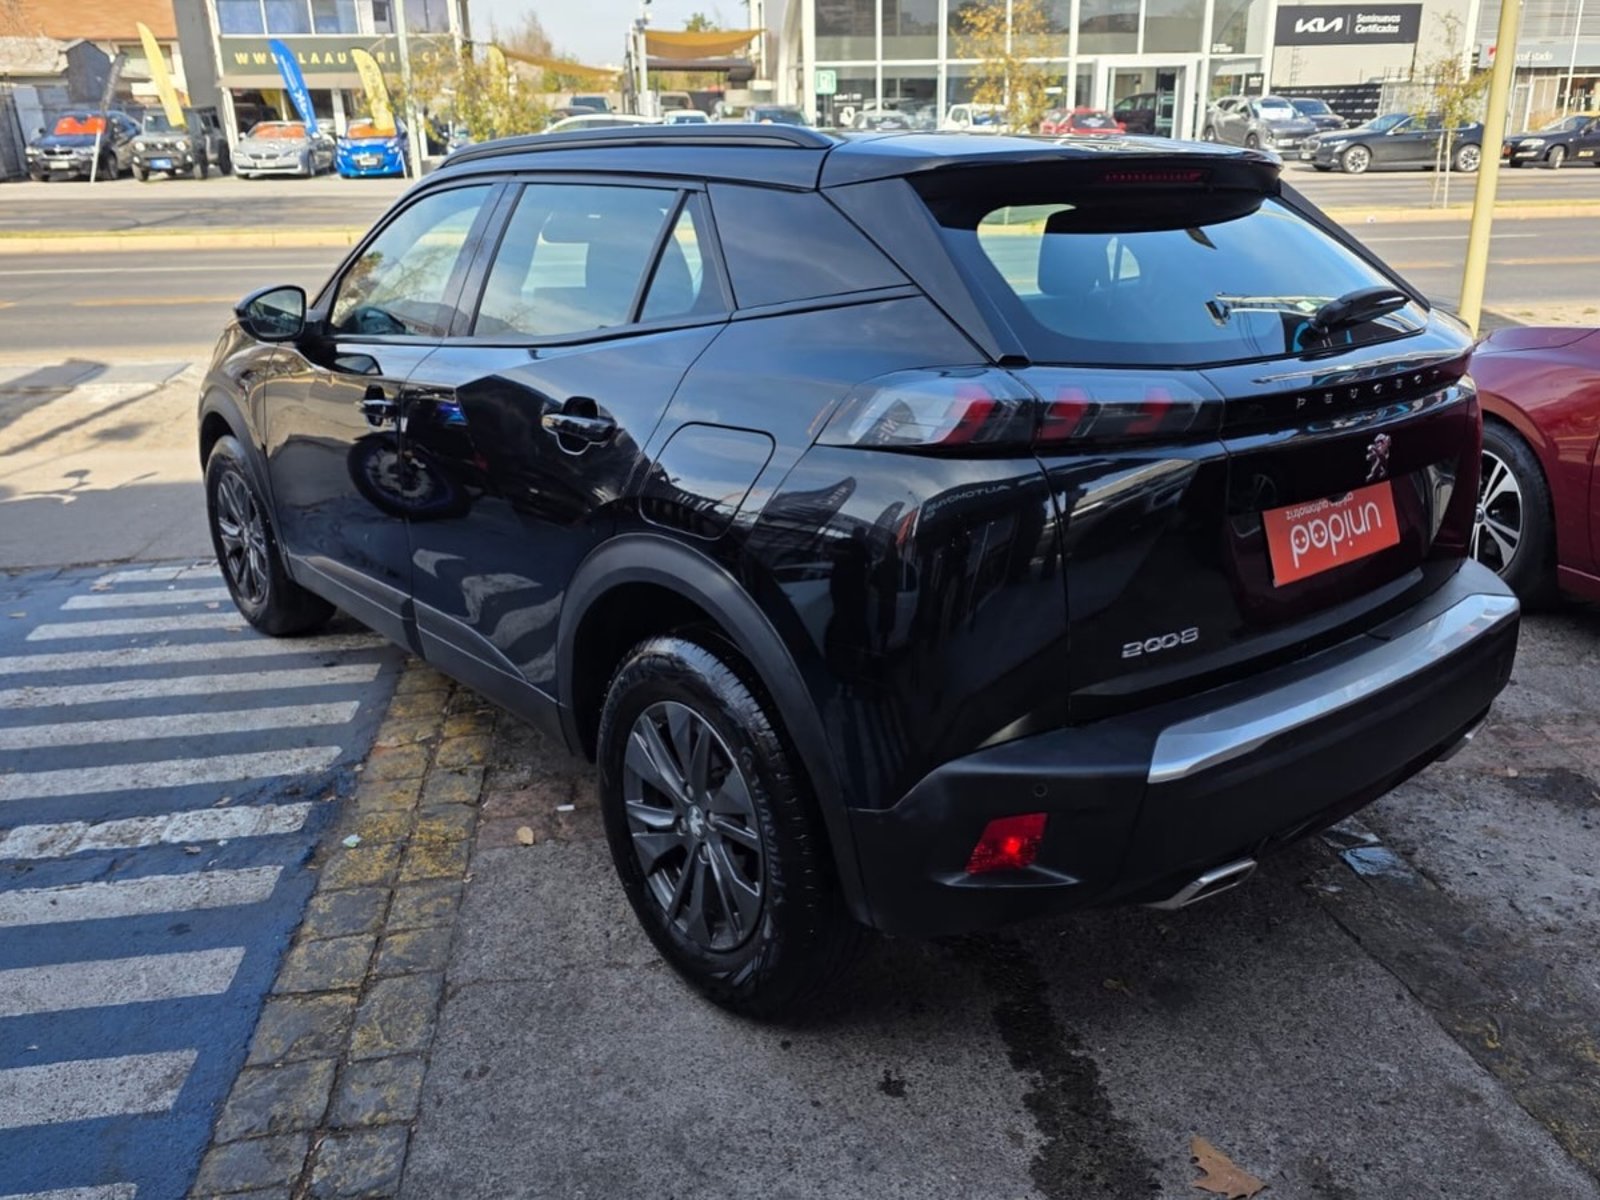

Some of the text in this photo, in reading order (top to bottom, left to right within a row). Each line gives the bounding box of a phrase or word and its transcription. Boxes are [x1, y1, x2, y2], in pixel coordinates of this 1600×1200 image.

[1295, 17, 1343, 32] KIA
[1354, 24, 1399, 34] Certificados
[1356, 13, 1401, 23] Seminuevos
[1296, 370, 1440, 409] PEUGEOT
[1286, 498, 1330, 521] automotriz
[1290, 502, 1382, 569] unidad
[1121, 627, 1199, 659] 2008
